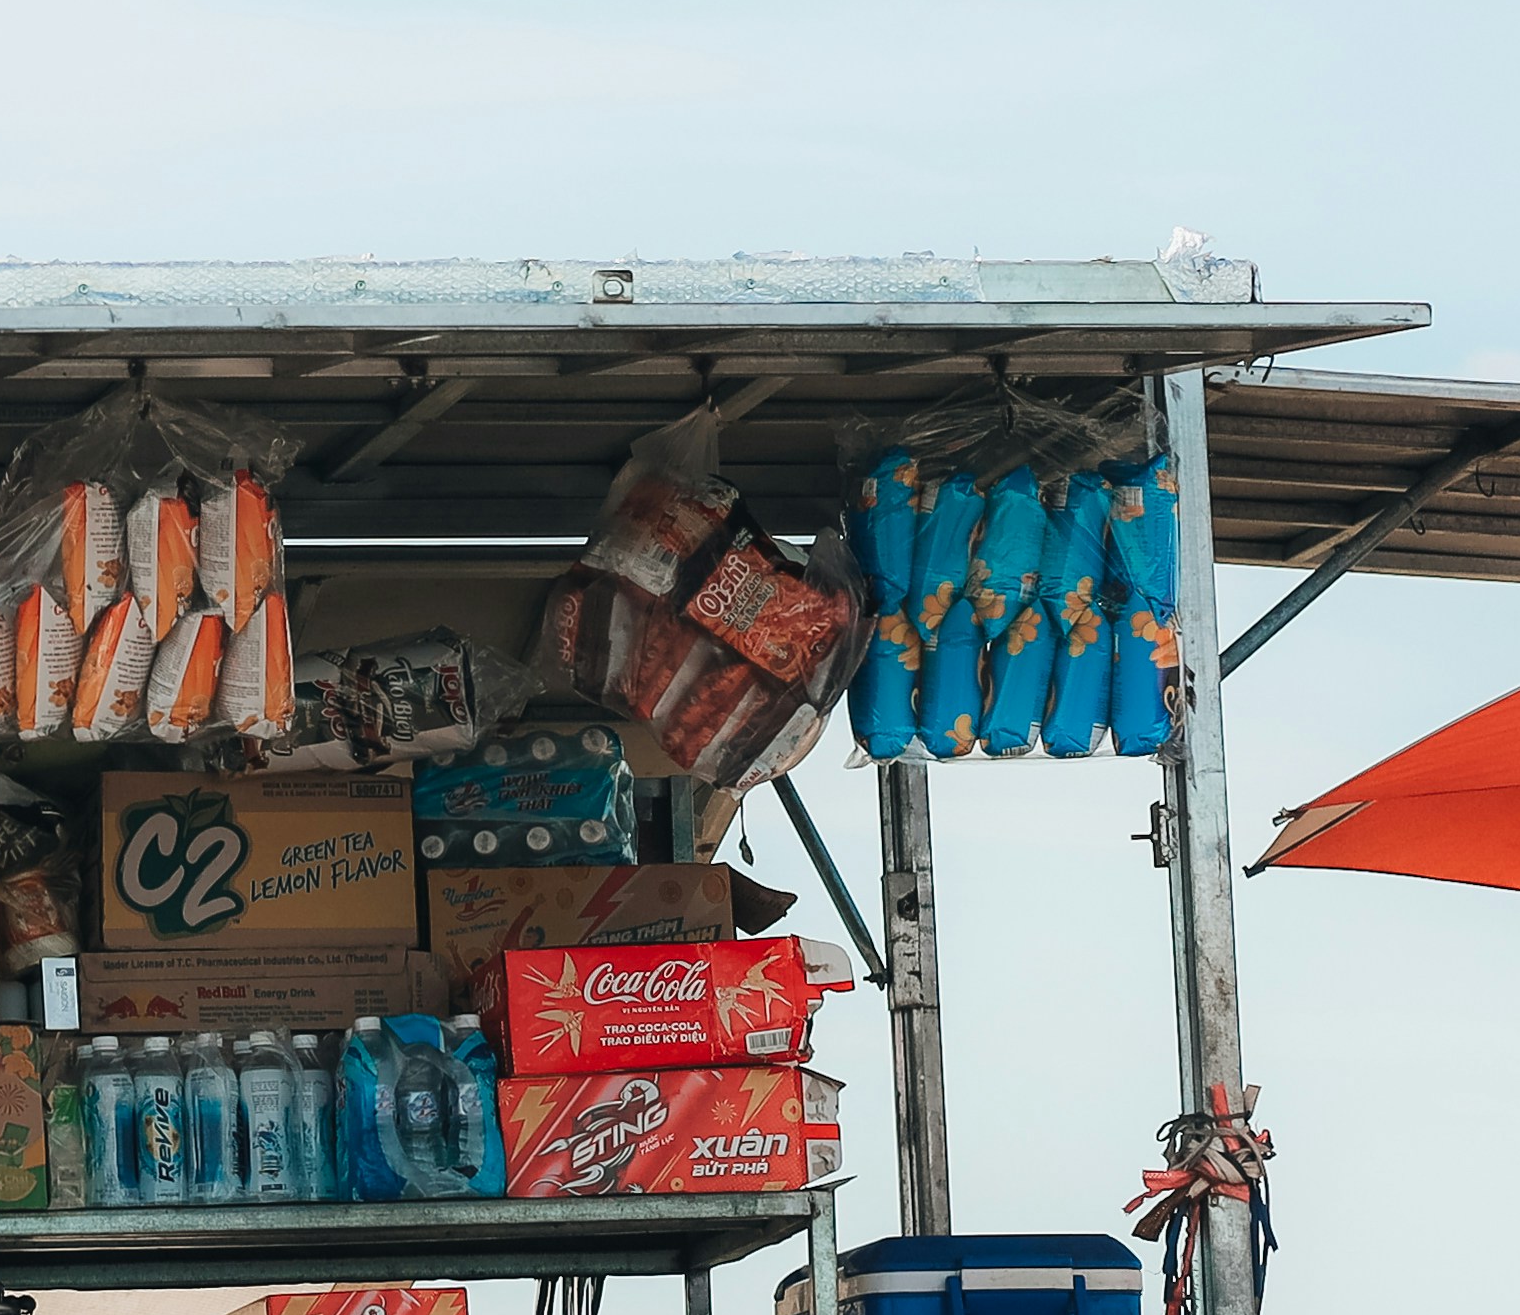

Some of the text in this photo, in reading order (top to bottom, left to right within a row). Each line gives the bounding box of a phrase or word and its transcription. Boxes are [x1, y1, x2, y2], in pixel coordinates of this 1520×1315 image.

[696, 554, 750, 618] Oishi
[281, 830, 374, 868] GREEN TEA
[122, 812, 242, 927] C2
[249, 849, 407, 903] LEMON FLAVOR
[165, 957, 175, 968] of
[253, 988, 288, 1000] Energy
[289, 987, 316, 999] Drink
[582, 958, 712, 1006] Coca-Cola
[599, 1036, 634, 1047] TRAO
[603, 1021, 702, 1035] TRAO COCA-COLA
[571, 1103, 669, 1170] STING
[688, 1127, 790, 1160] xuân
